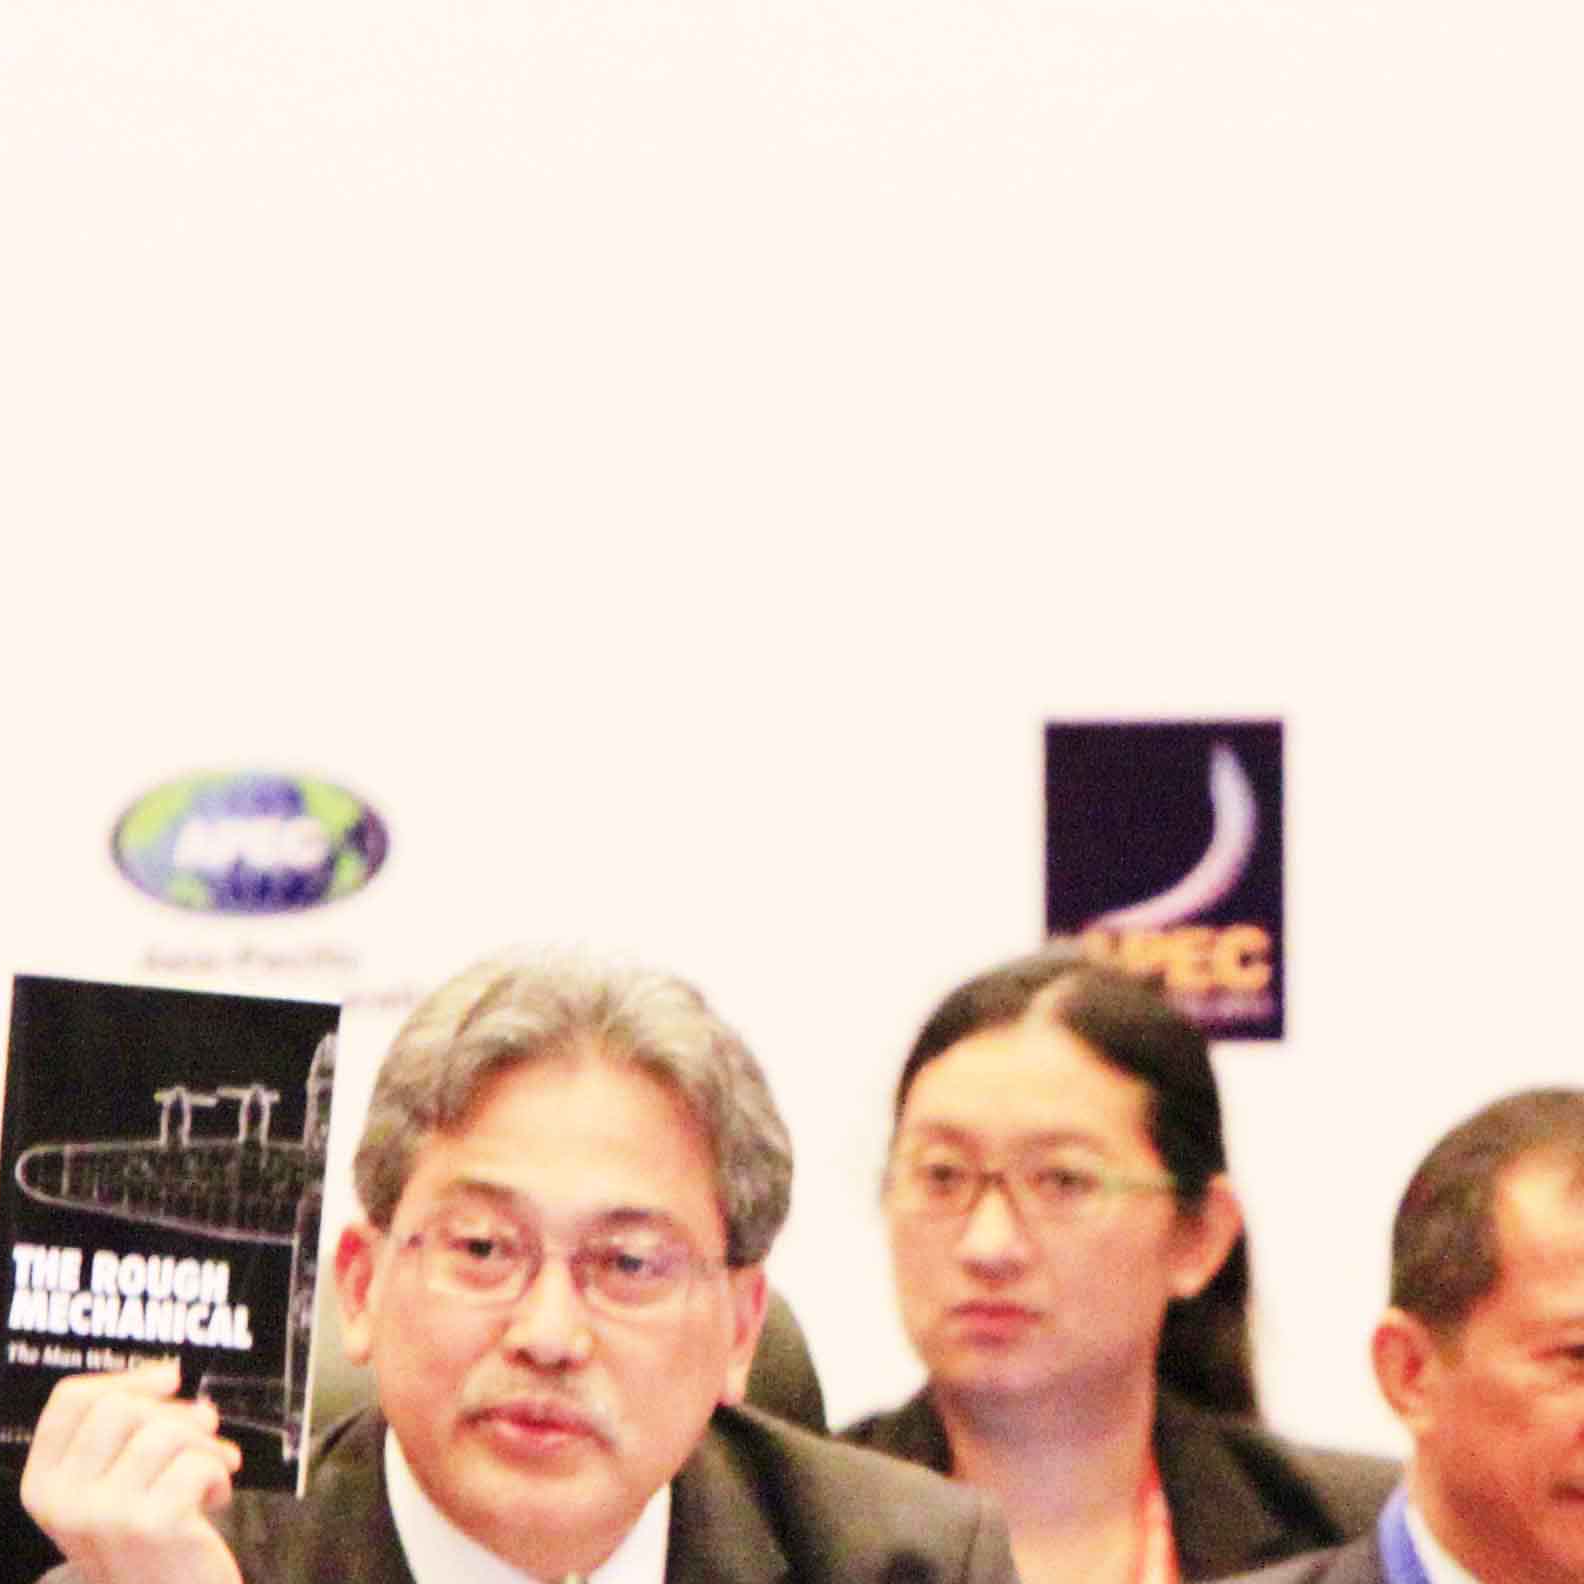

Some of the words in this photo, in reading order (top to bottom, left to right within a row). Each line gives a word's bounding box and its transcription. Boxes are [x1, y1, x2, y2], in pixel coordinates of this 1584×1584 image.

[12, 1241, 83, 1292] THE
[90, 1249, 231, 1303] ROUGH
[7, 1289, 253, 1350] MECHANICAL
[7, 1340, 40, 1366] The
